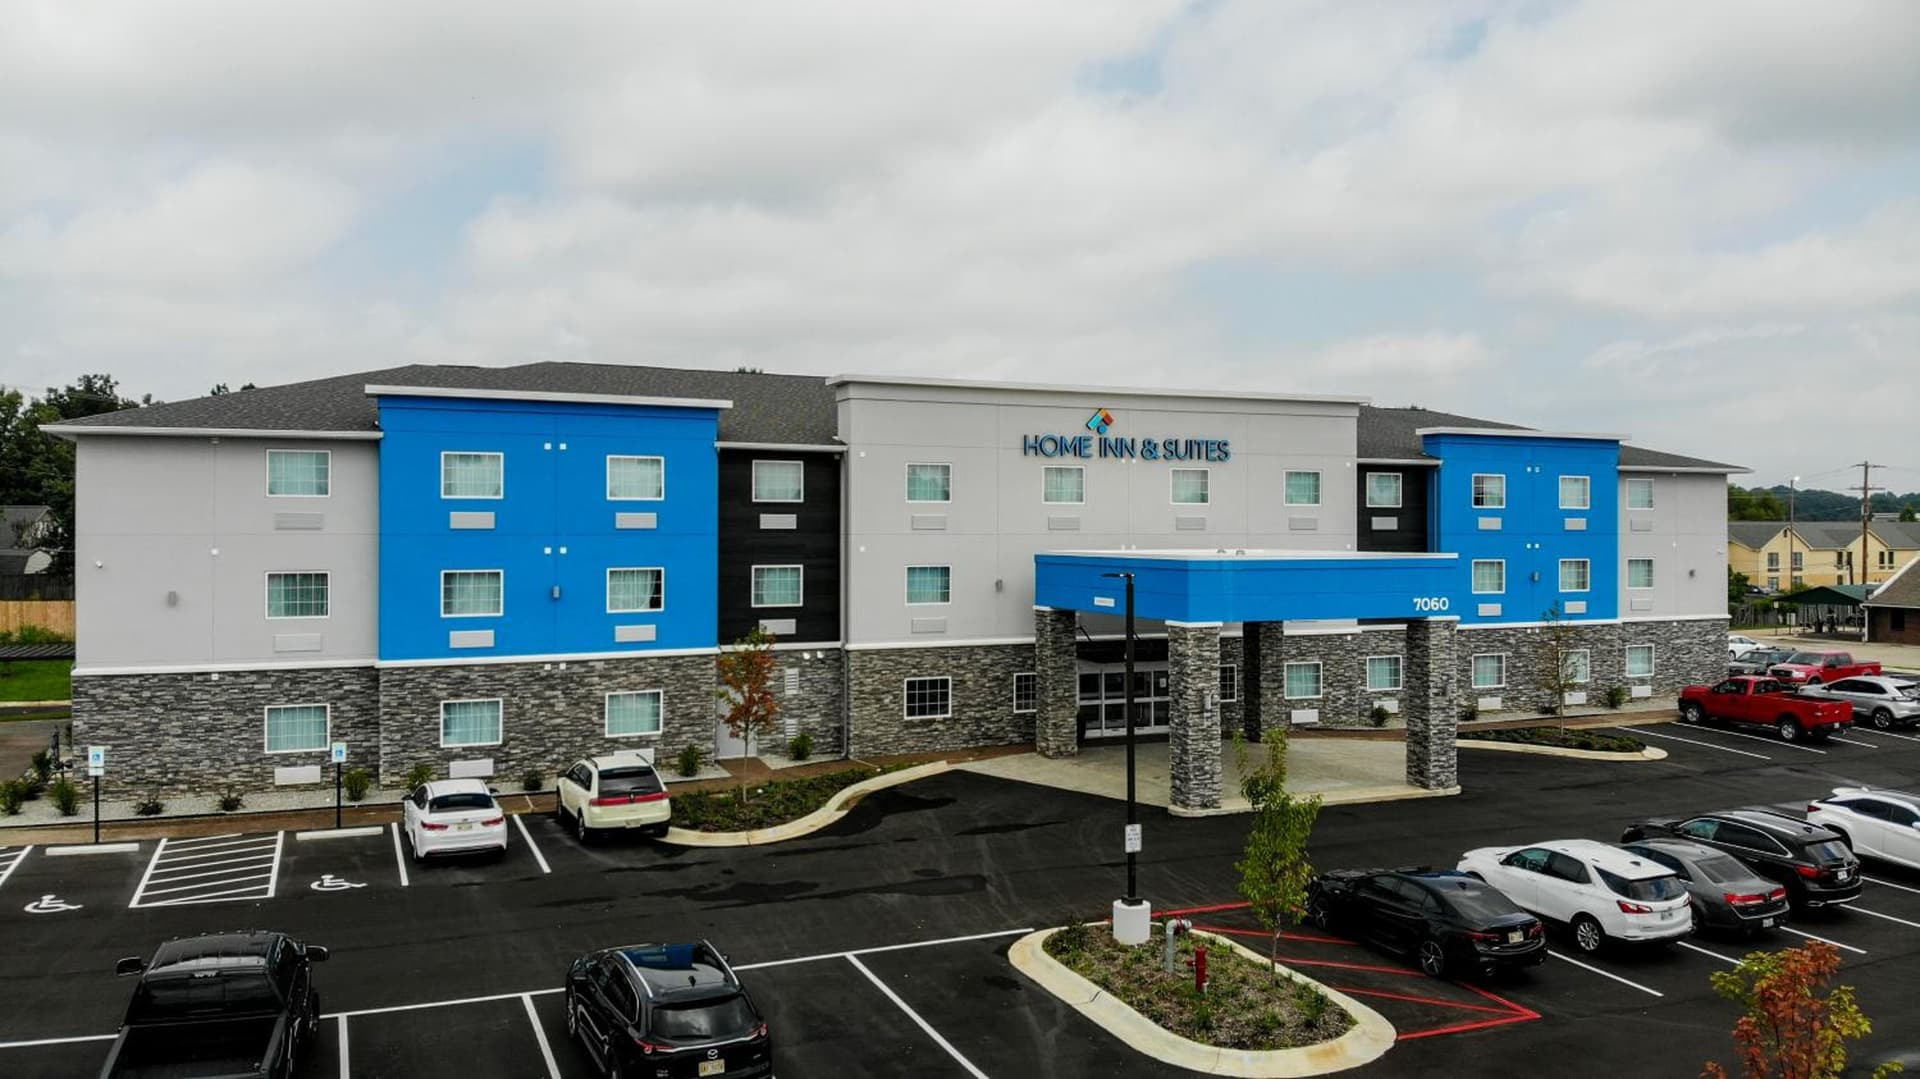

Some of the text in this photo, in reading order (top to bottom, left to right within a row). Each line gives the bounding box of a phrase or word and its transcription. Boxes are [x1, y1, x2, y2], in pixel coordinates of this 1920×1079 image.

[1023, 434, 1232, 462] HOME INN & SUITES
[1412, 597, 1449, 611] 7060
